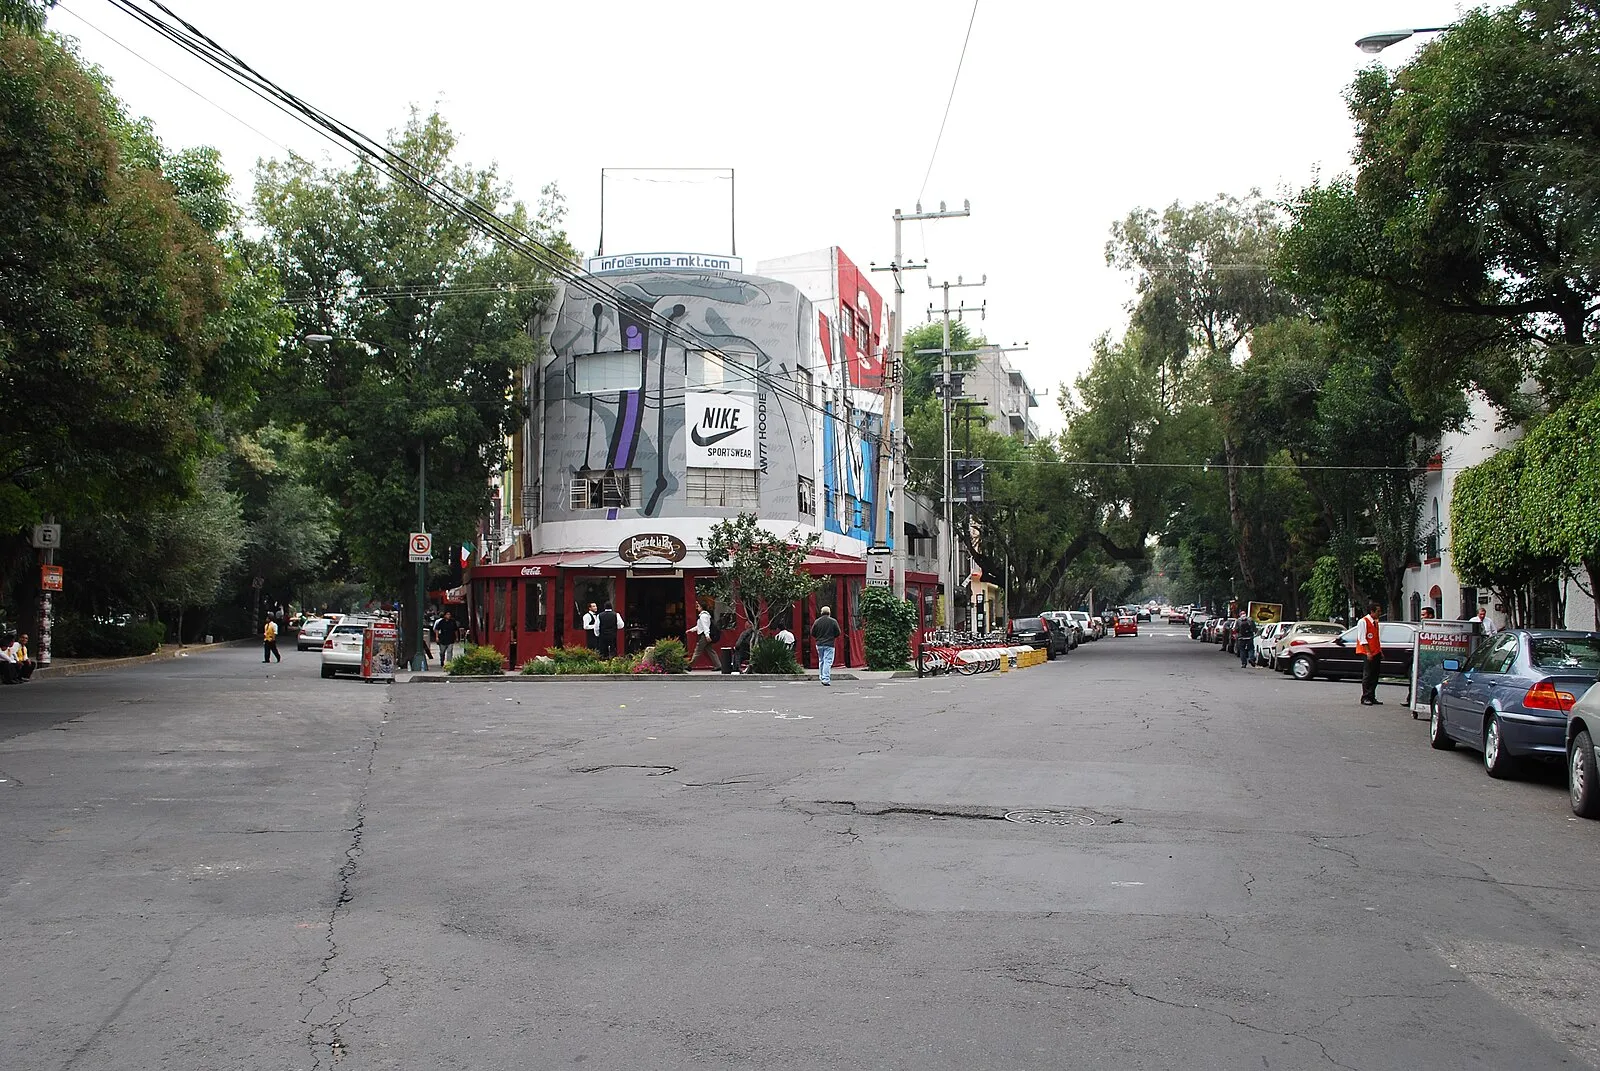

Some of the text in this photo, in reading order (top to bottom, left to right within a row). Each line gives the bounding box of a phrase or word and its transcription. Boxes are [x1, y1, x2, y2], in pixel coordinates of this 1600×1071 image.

[601, 256, 730, 271] info@suma-mkt.com
[702, 407, 741, 430] NIKE
[758, 393, 769, 476] AW77 HOODIE
[707, 447, 752, 459] SPORTSWEAR
[1420, 632, 1468, 642] CAMPECHE
